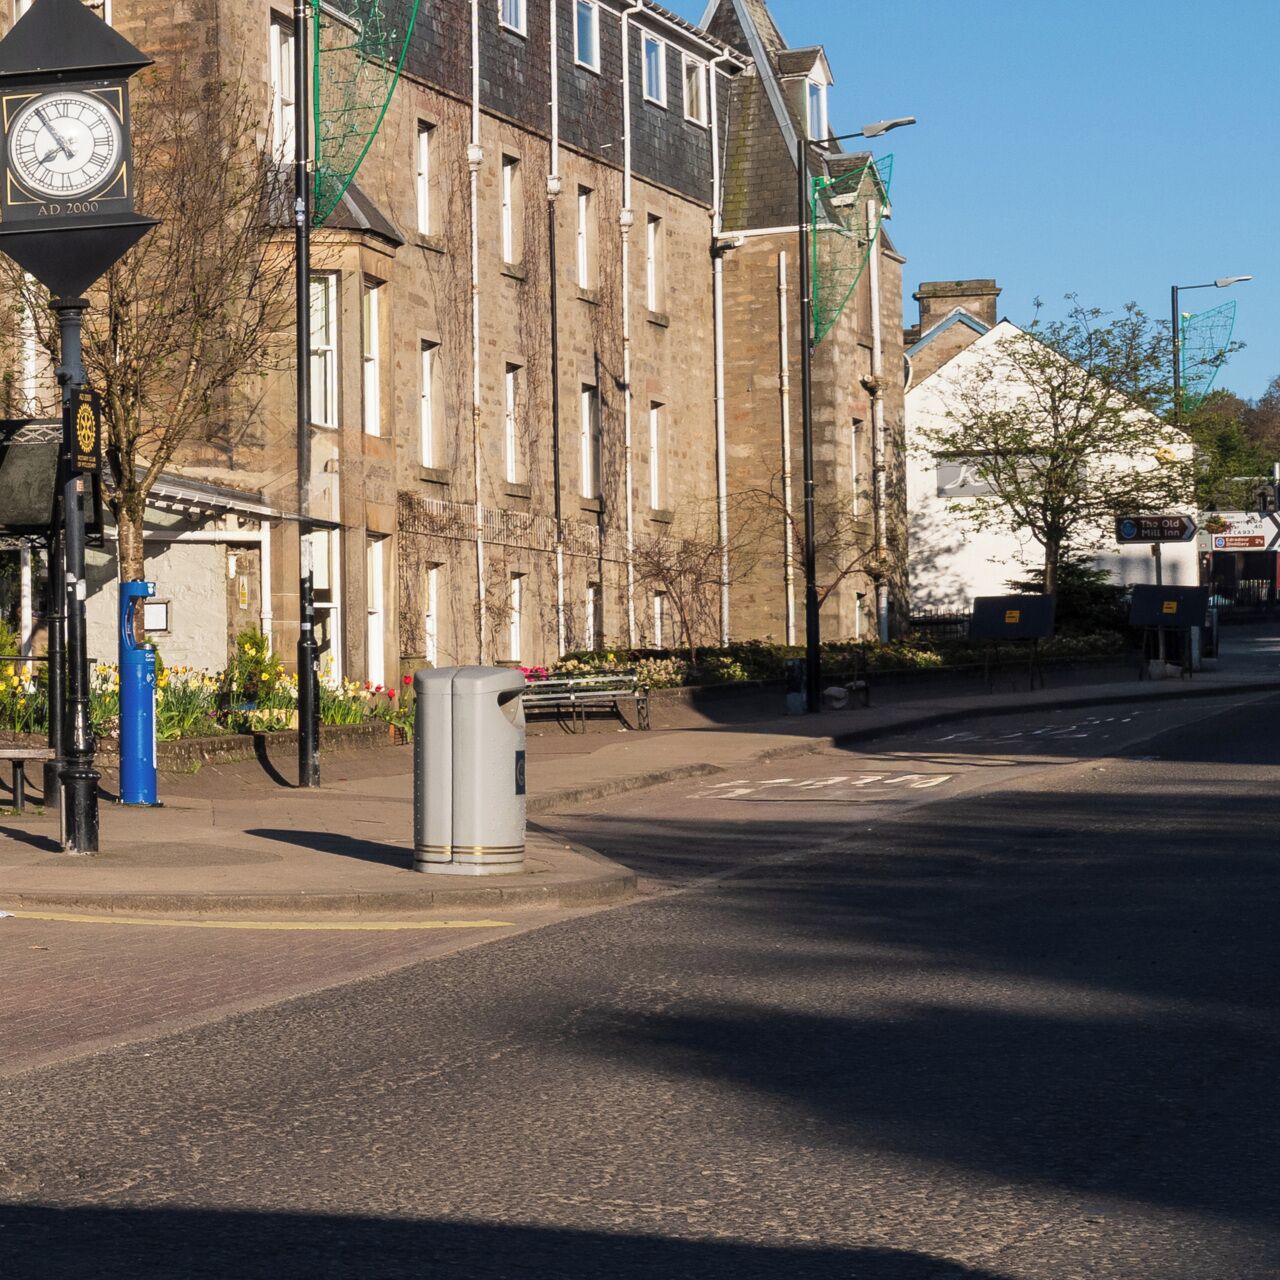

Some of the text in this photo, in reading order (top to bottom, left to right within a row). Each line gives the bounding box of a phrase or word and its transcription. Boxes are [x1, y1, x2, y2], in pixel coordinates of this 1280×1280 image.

[38, 202, 99, 216] AD 2000
[1140, 519, 1179, 528] The Old
[1141, 529, 1180, 537] Mill Inn
